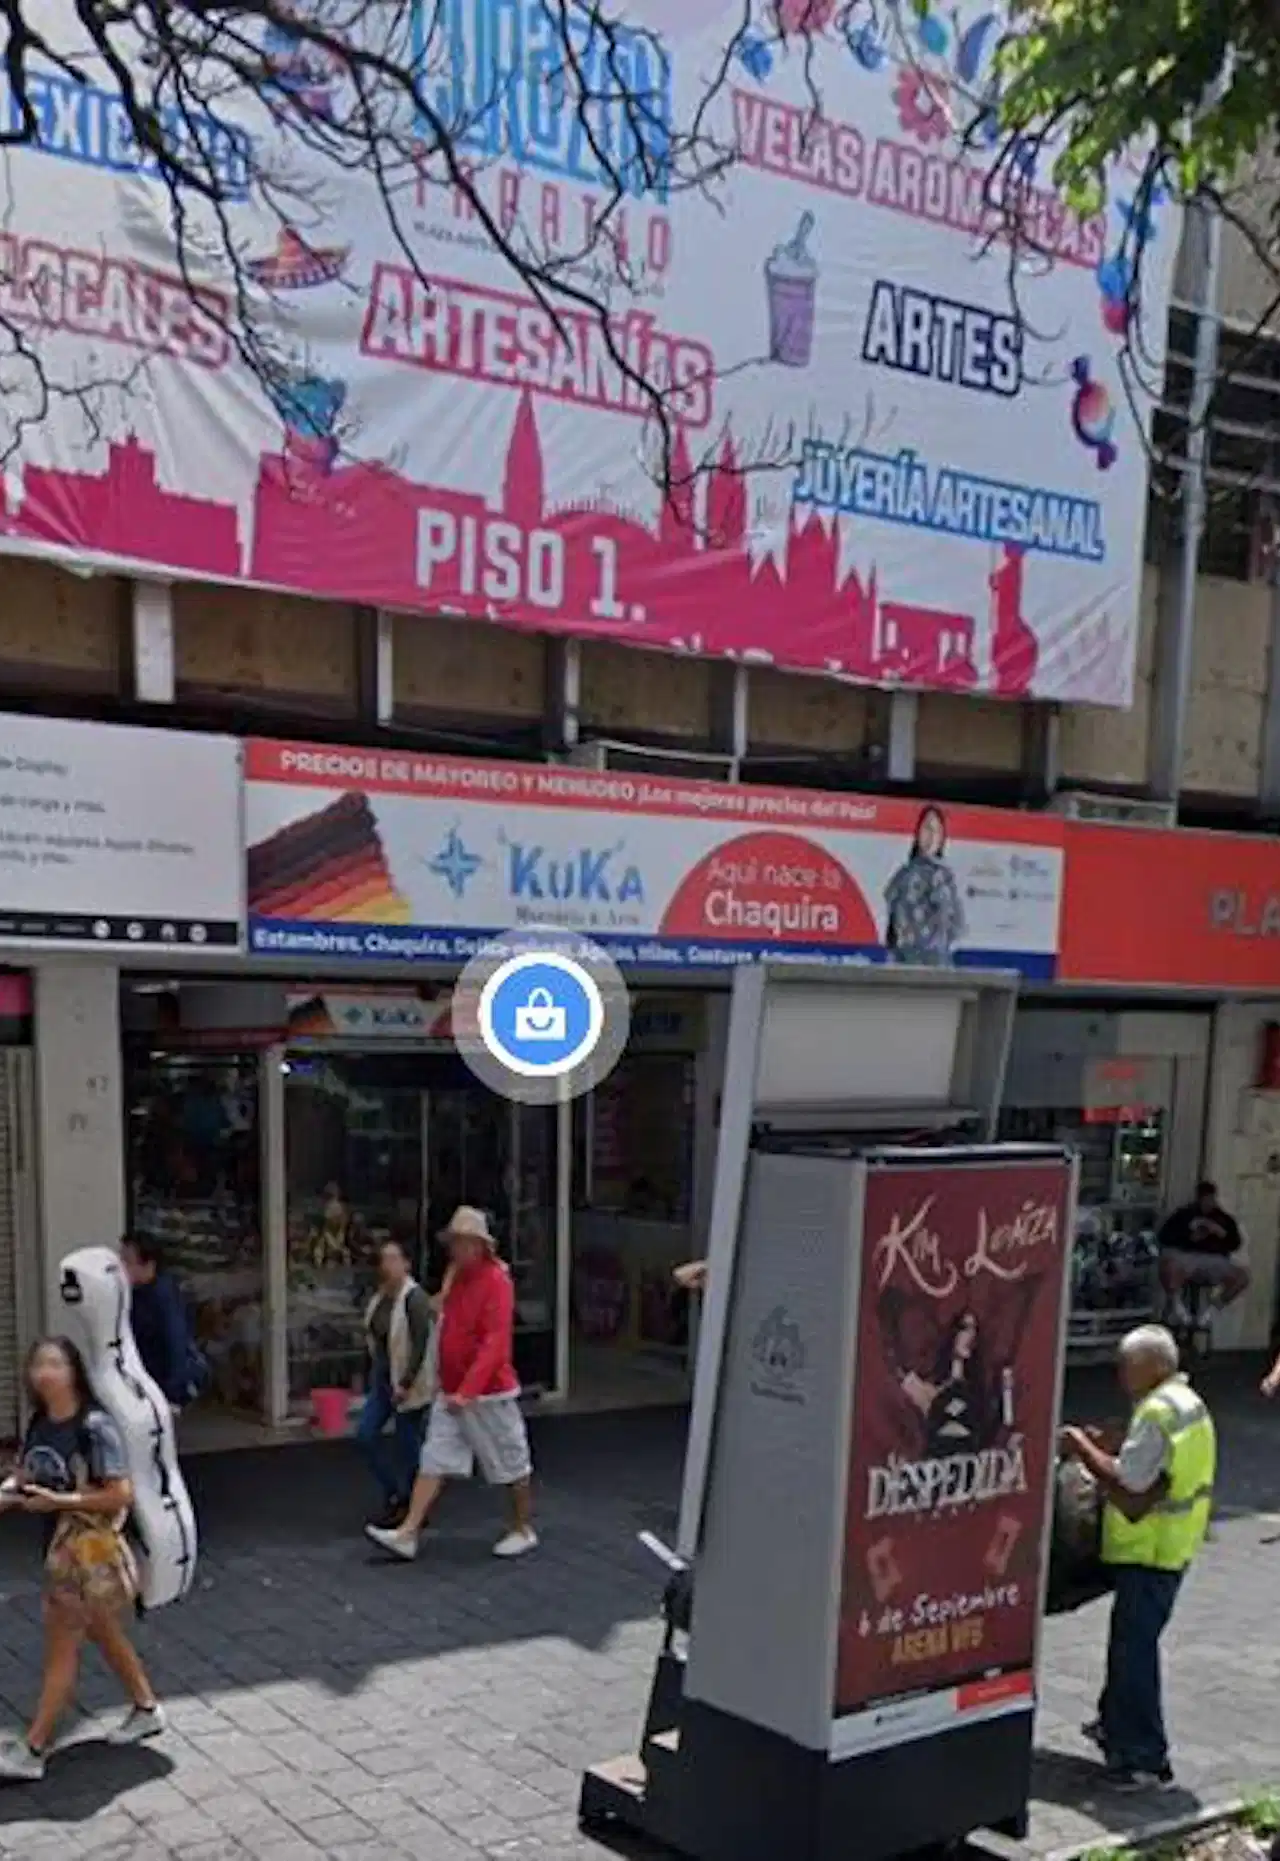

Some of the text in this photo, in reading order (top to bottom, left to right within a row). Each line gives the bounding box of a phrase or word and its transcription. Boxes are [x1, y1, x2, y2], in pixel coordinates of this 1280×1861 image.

[733, 89, 864, 197] VELAS
[360, 260, 714, 430] ARTESANÍAS
[862, 279, 1022, 397] ARTES
[931, 468, 1106, 562] ARTESANAL
[416, 507, 647, 622] PISO 1.
[280, 750, 378, 779] PRECIOS
[381, 759, 409, 781] DE
[414, 763, 518, 791] MAYOREO
[522, 776, 534, 792] Y
[538, 776, 634, 800] MENUDEO
[253, 928, 363, 953] Estambres,
[705, 891, 841, 937] Chaquira
[876, 1605, 905, 1635] de
[909, 1583, 1021, 1627] Septiembre
